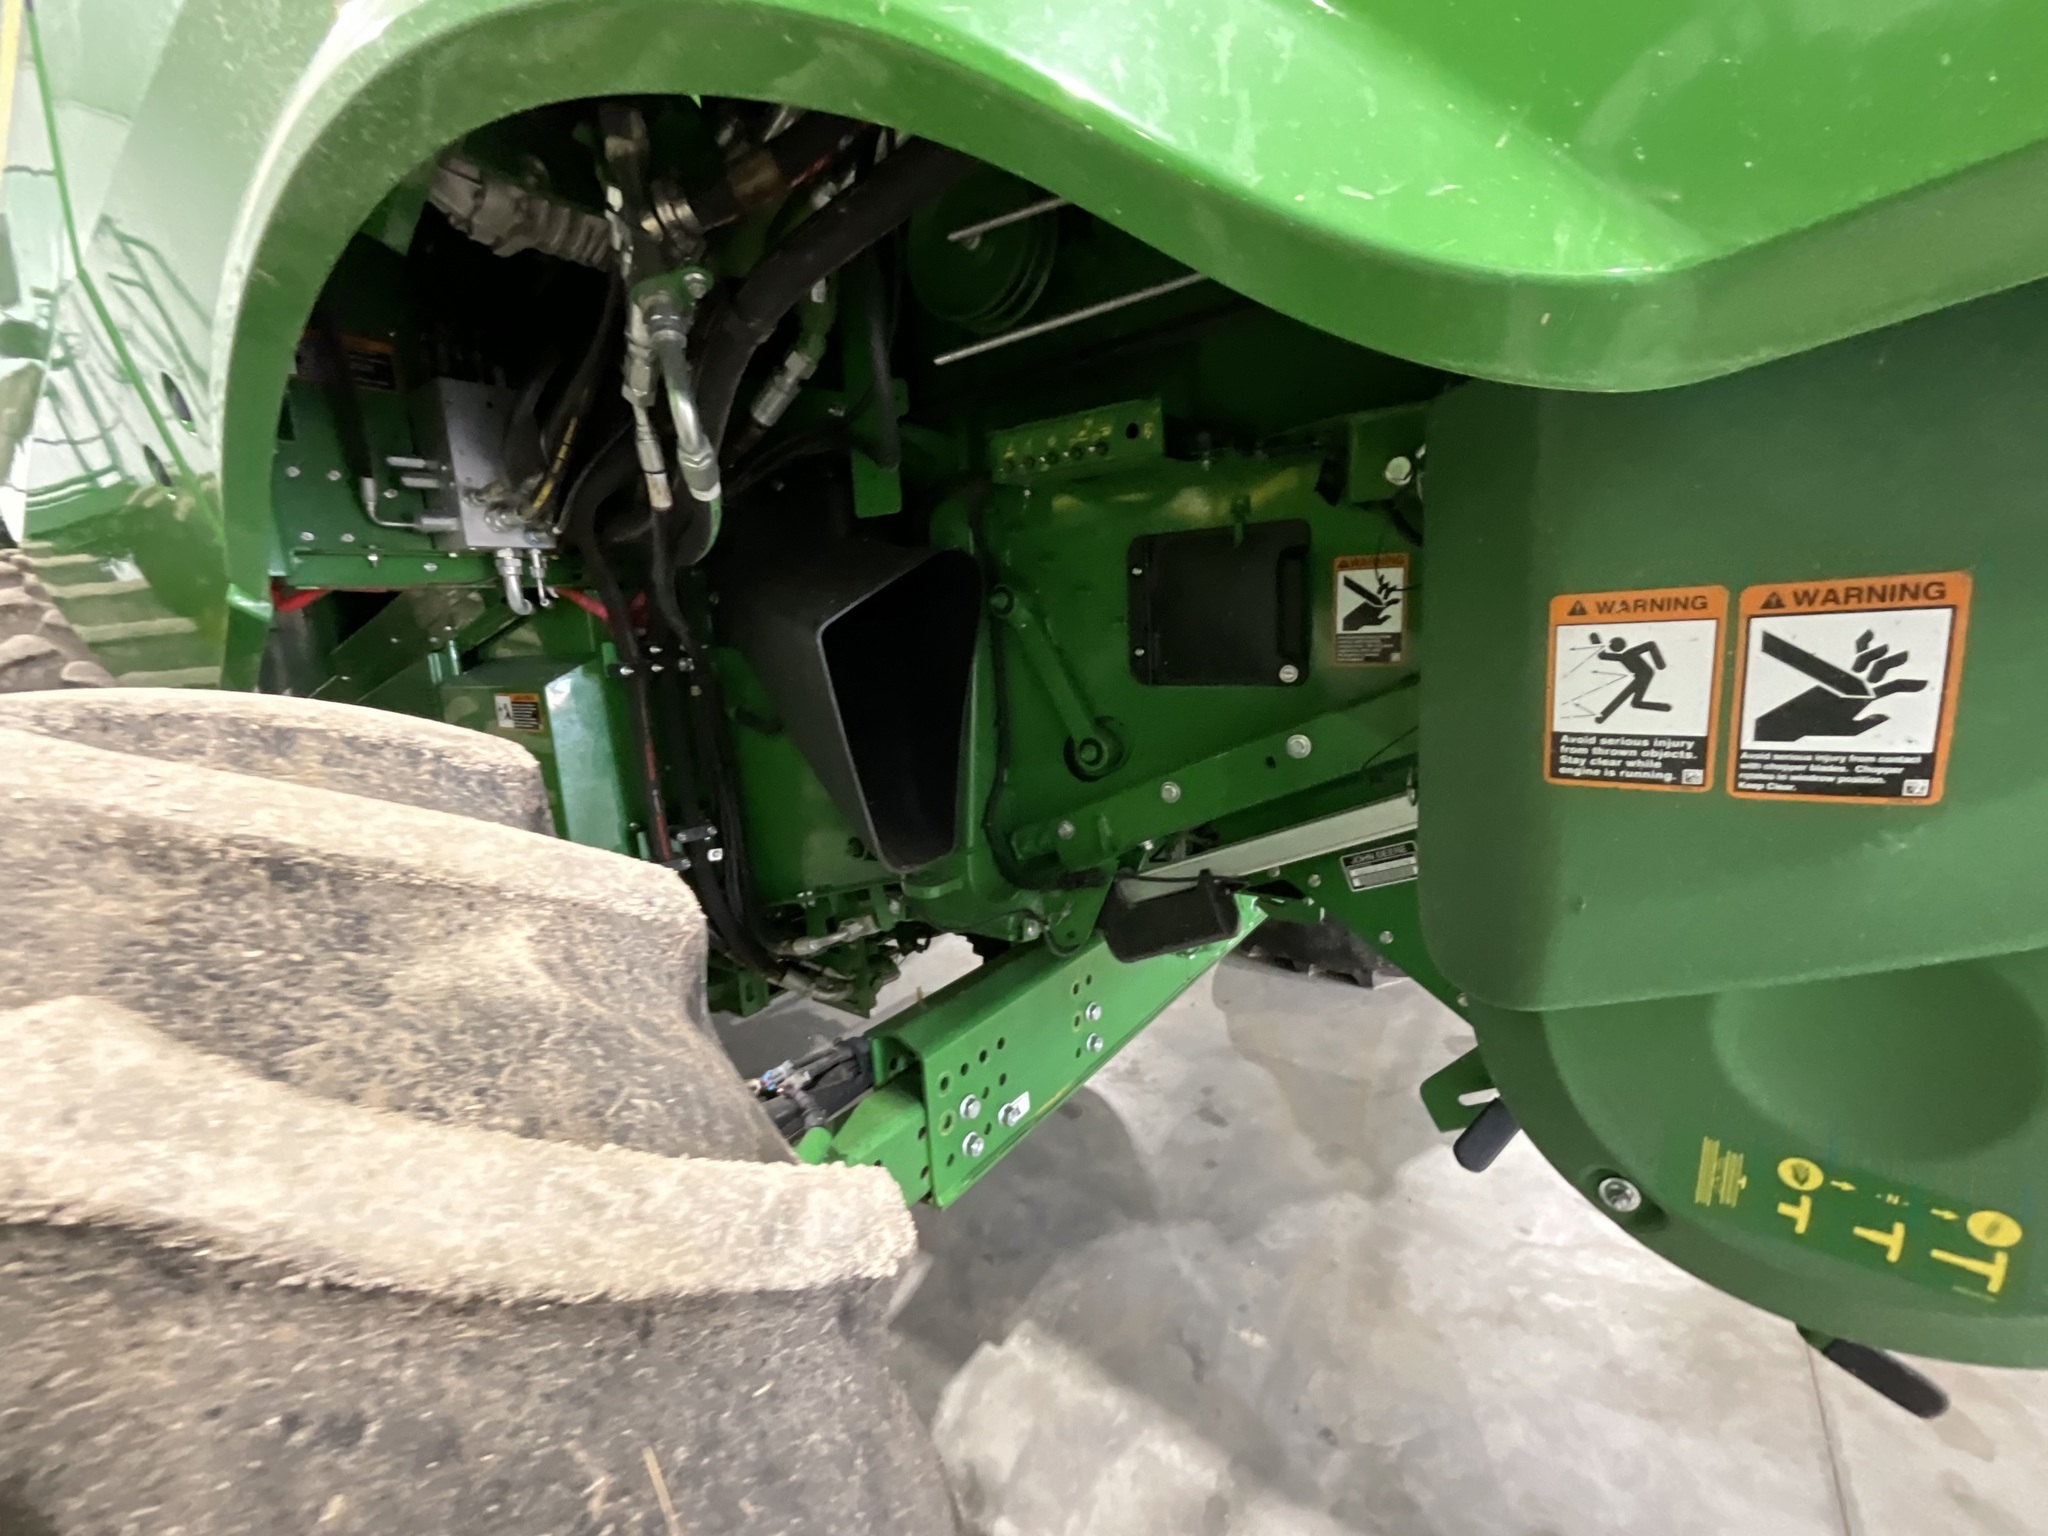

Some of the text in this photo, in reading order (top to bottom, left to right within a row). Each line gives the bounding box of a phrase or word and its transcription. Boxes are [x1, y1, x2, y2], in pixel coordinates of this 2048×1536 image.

[1794, 581, 1946, 607] WARNING
[1595, 595, 1708, 615] WARNING
[1560, 735, 1695, 750] Avoid serious injury
[1559, 745, 1698, 760] from thrown objects.
[1559, 755, 1663, 769] Stay clear while
[1558, 766, 1677, 783] engine is running.
